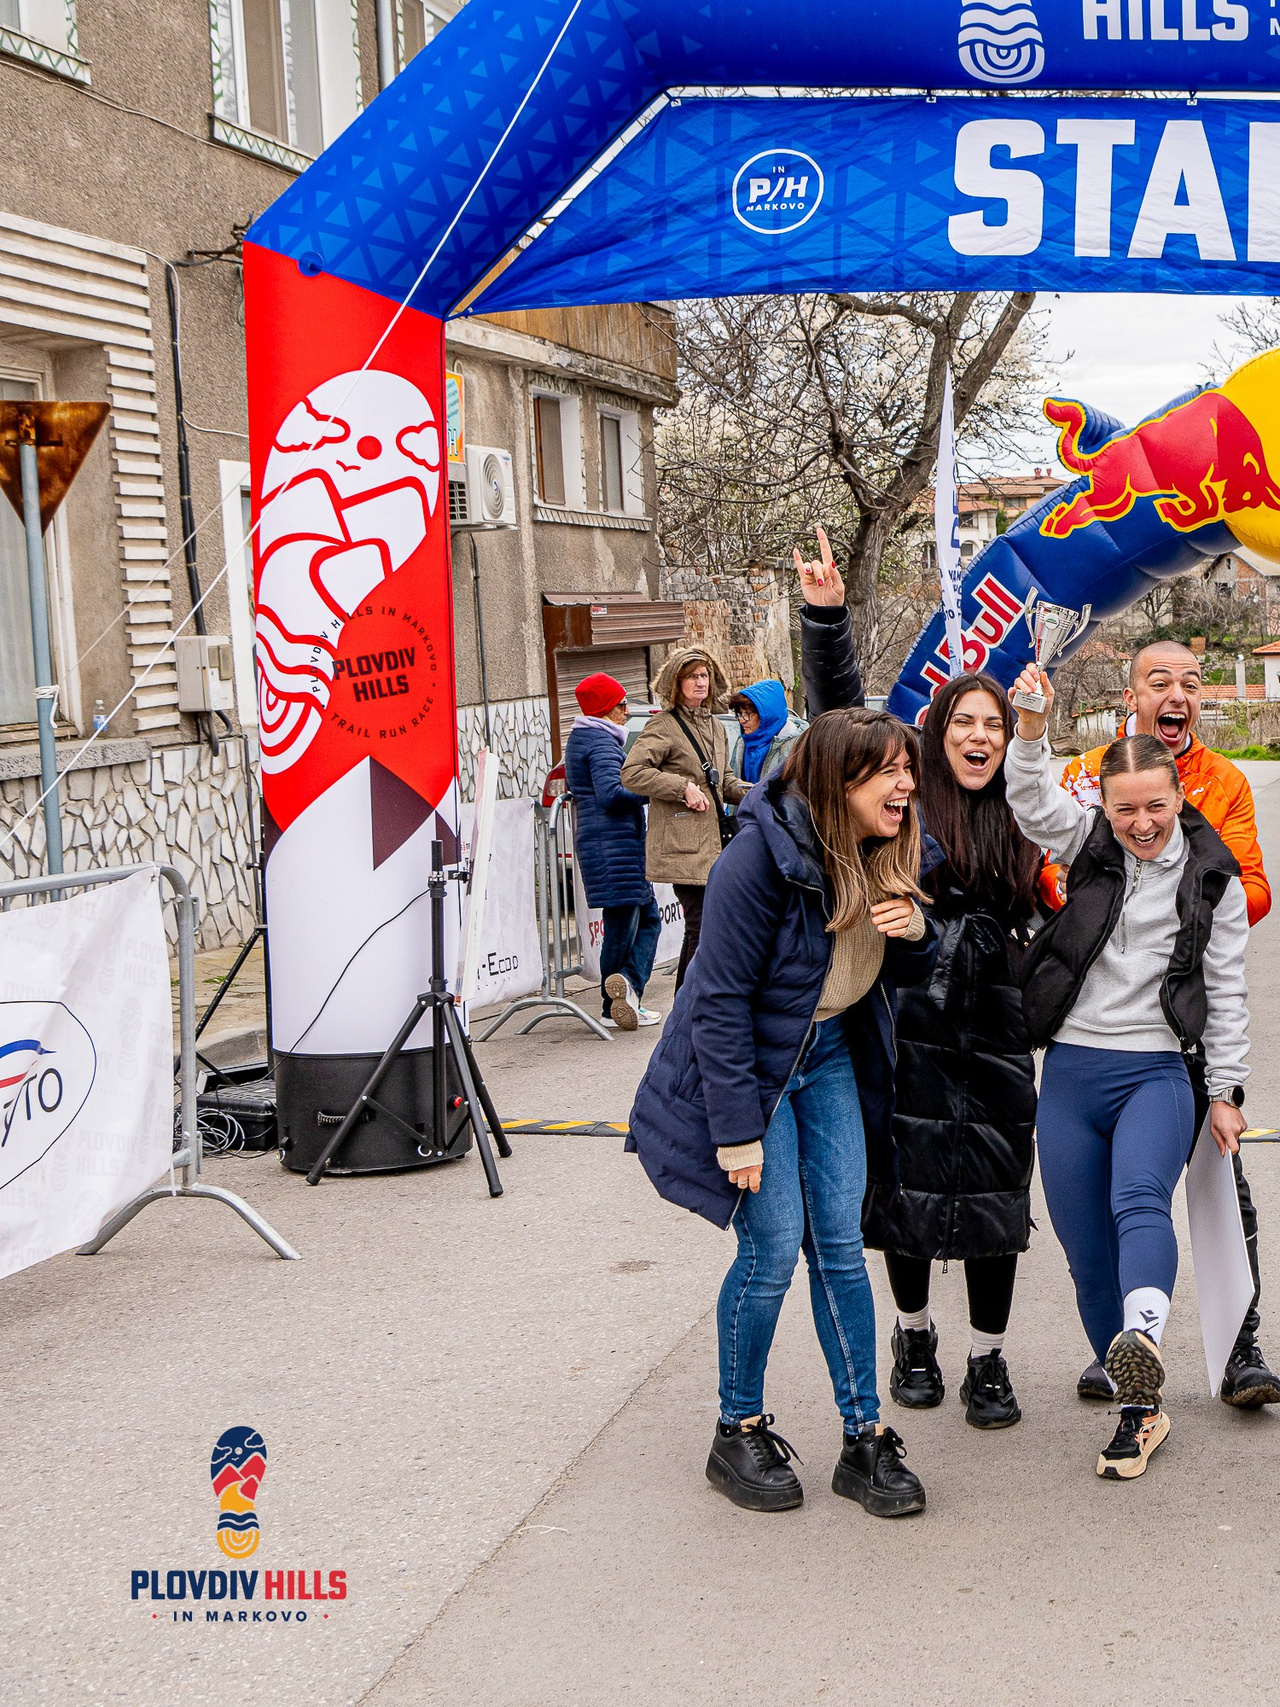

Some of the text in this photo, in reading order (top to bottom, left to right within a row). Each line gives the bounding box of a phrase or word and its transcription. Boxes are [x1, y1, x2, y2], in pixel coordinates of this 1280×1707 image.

[1083, 0, 1249, 41] HILLS
[772, 166, 786, 174] IN
[745, 202, 805, 212] MARKOVO
[331, 606, 373, 629] HILLS
[381, 606, 396, 617] IN
[402, 613, 437, 671] MARKOVO
[332, 647, 416, 680] PLOVDIV
[352, 675, 410, 703] HILLS
[331, 697, 434, 739] TRAIL RUN RACE
